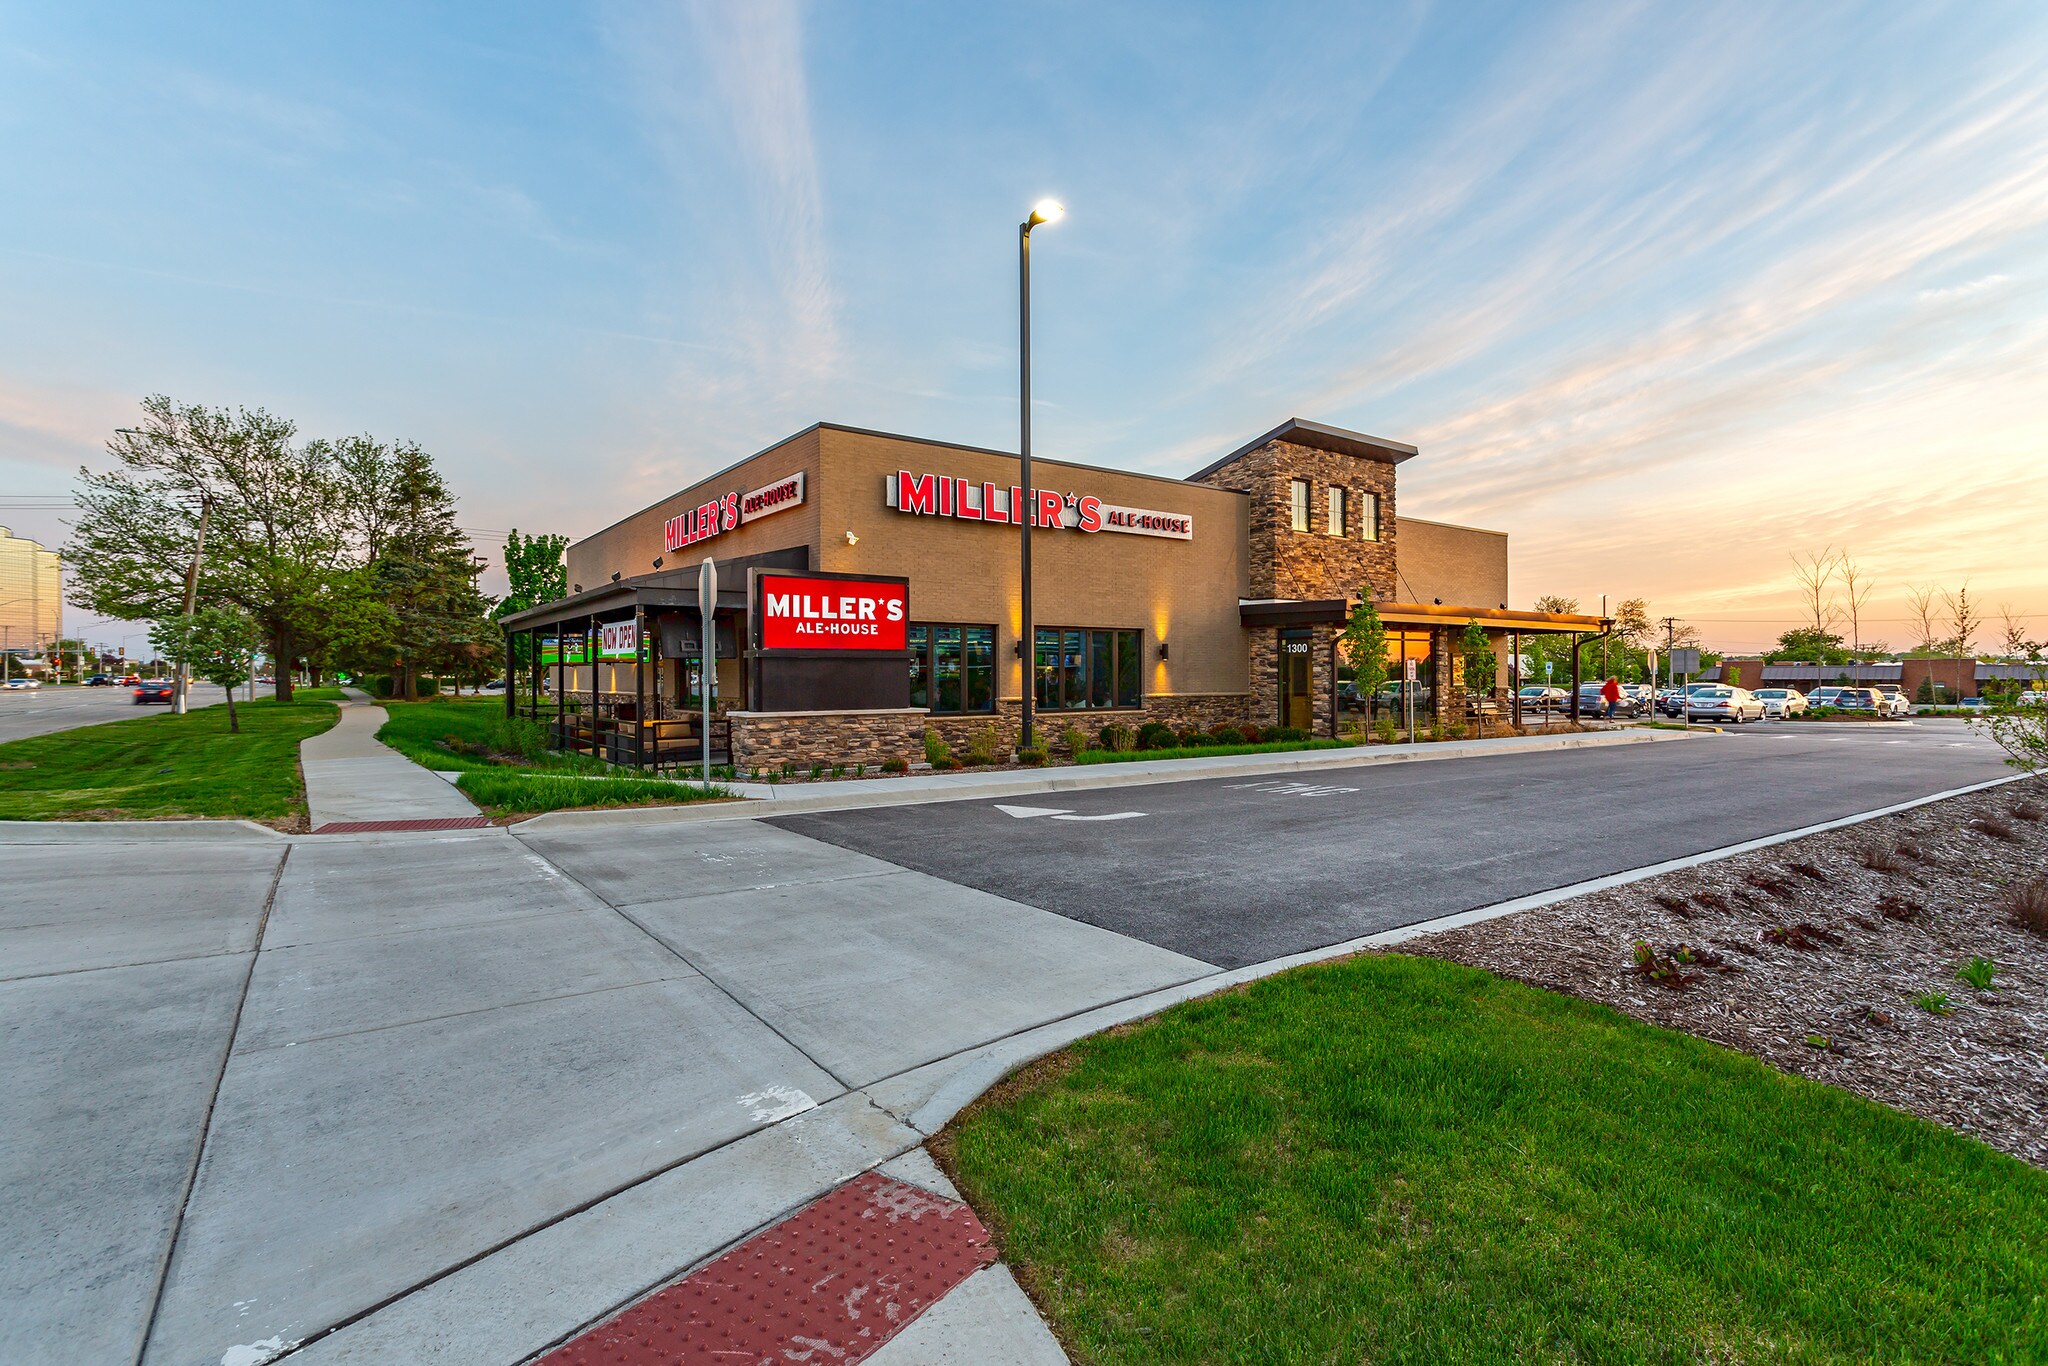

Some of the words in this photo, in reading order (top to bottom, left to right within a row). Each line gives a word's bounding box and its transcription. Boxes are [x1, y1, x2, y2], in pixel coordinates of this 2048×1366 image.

[899, 470, 1102, 533] MILLER'S
[664, 491, 739, 552] MILLER'S
[767, 593, 903, 621] MILLER'S
[602, 627, 617, 649] NOW
[619, 624, 636, 648] OPEN
[1287, 643, 1308, 653] 1300
